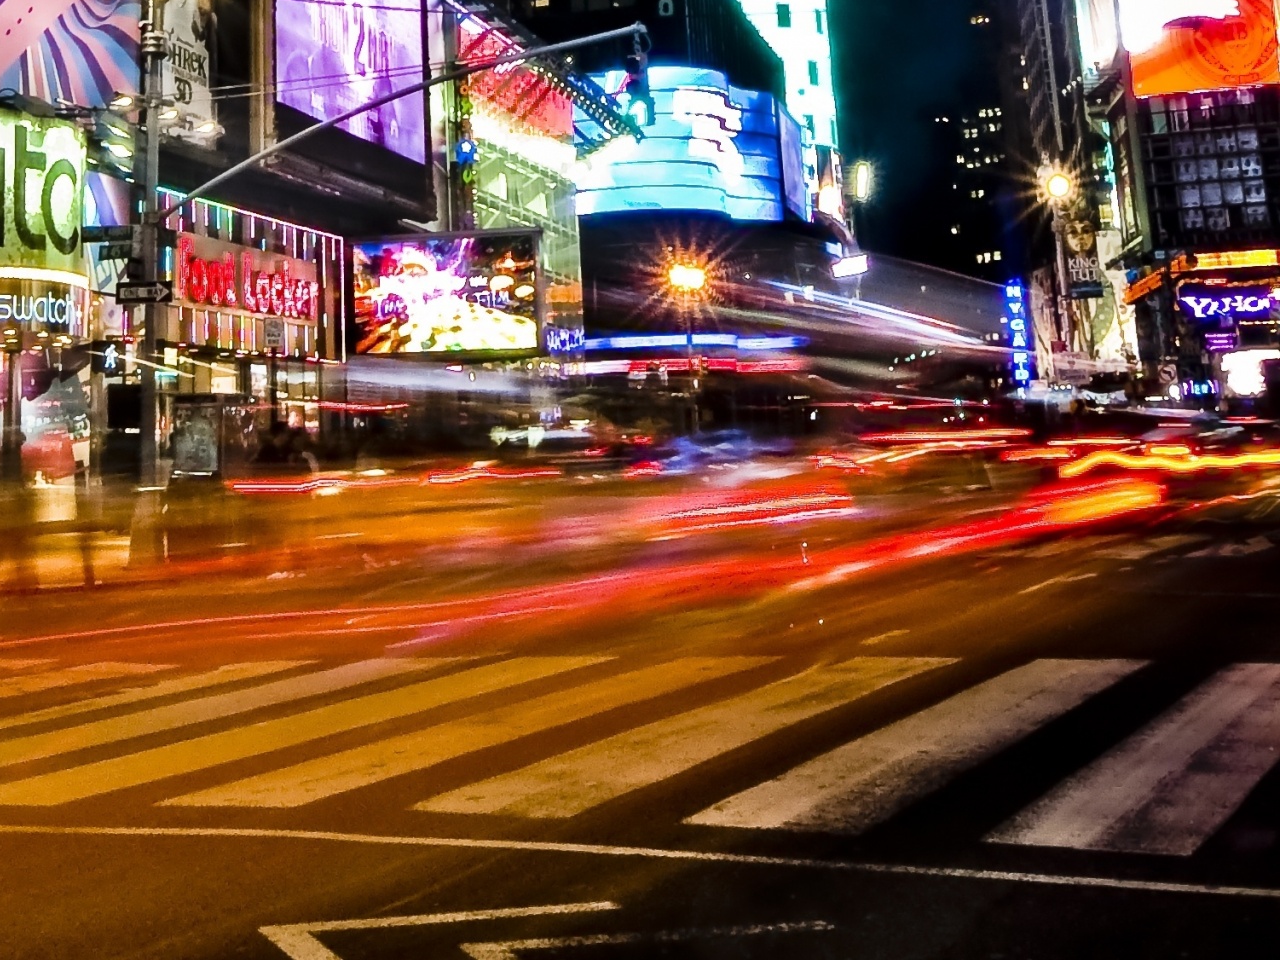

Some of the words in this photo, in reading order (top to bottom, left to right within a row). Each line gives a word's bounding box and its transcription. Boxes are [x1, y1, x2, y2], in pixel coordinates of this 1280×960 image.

[173, 76, 193, 105] 3D
[1067, 257, 1099, 270] KING
[1070, 269, 1100, 282] TUT
